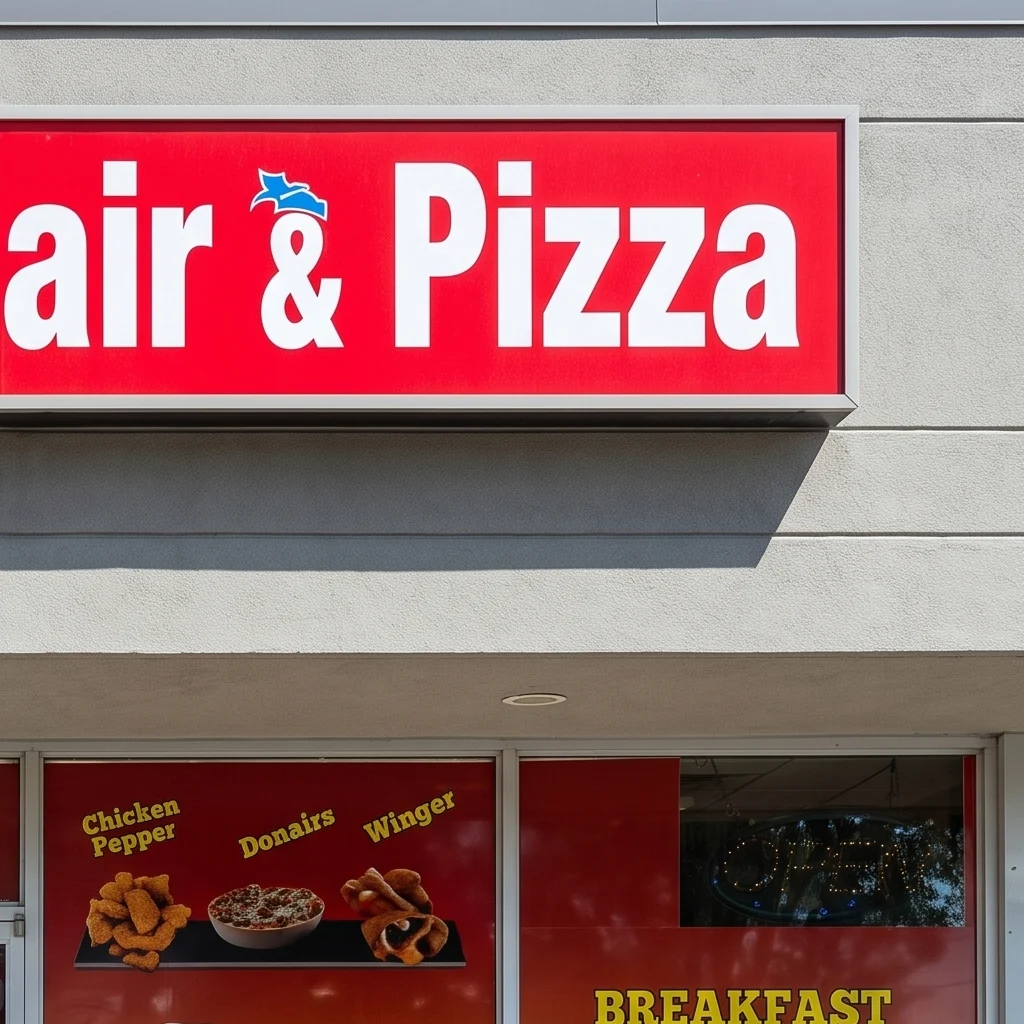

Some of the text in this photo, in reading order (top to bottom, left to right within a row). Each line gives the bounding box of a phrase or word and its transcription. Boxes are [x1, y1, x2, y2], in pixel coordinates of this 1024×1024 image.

[261, 211, 343, 350] &
[396, 161, 798, 350] Pizza
[82, 800, 181, 837] Chicken
[90, 822, 177, 858] Pepper
[238, 808, 336, 859] Donairs
[364, 791, 456, 844] Winger
